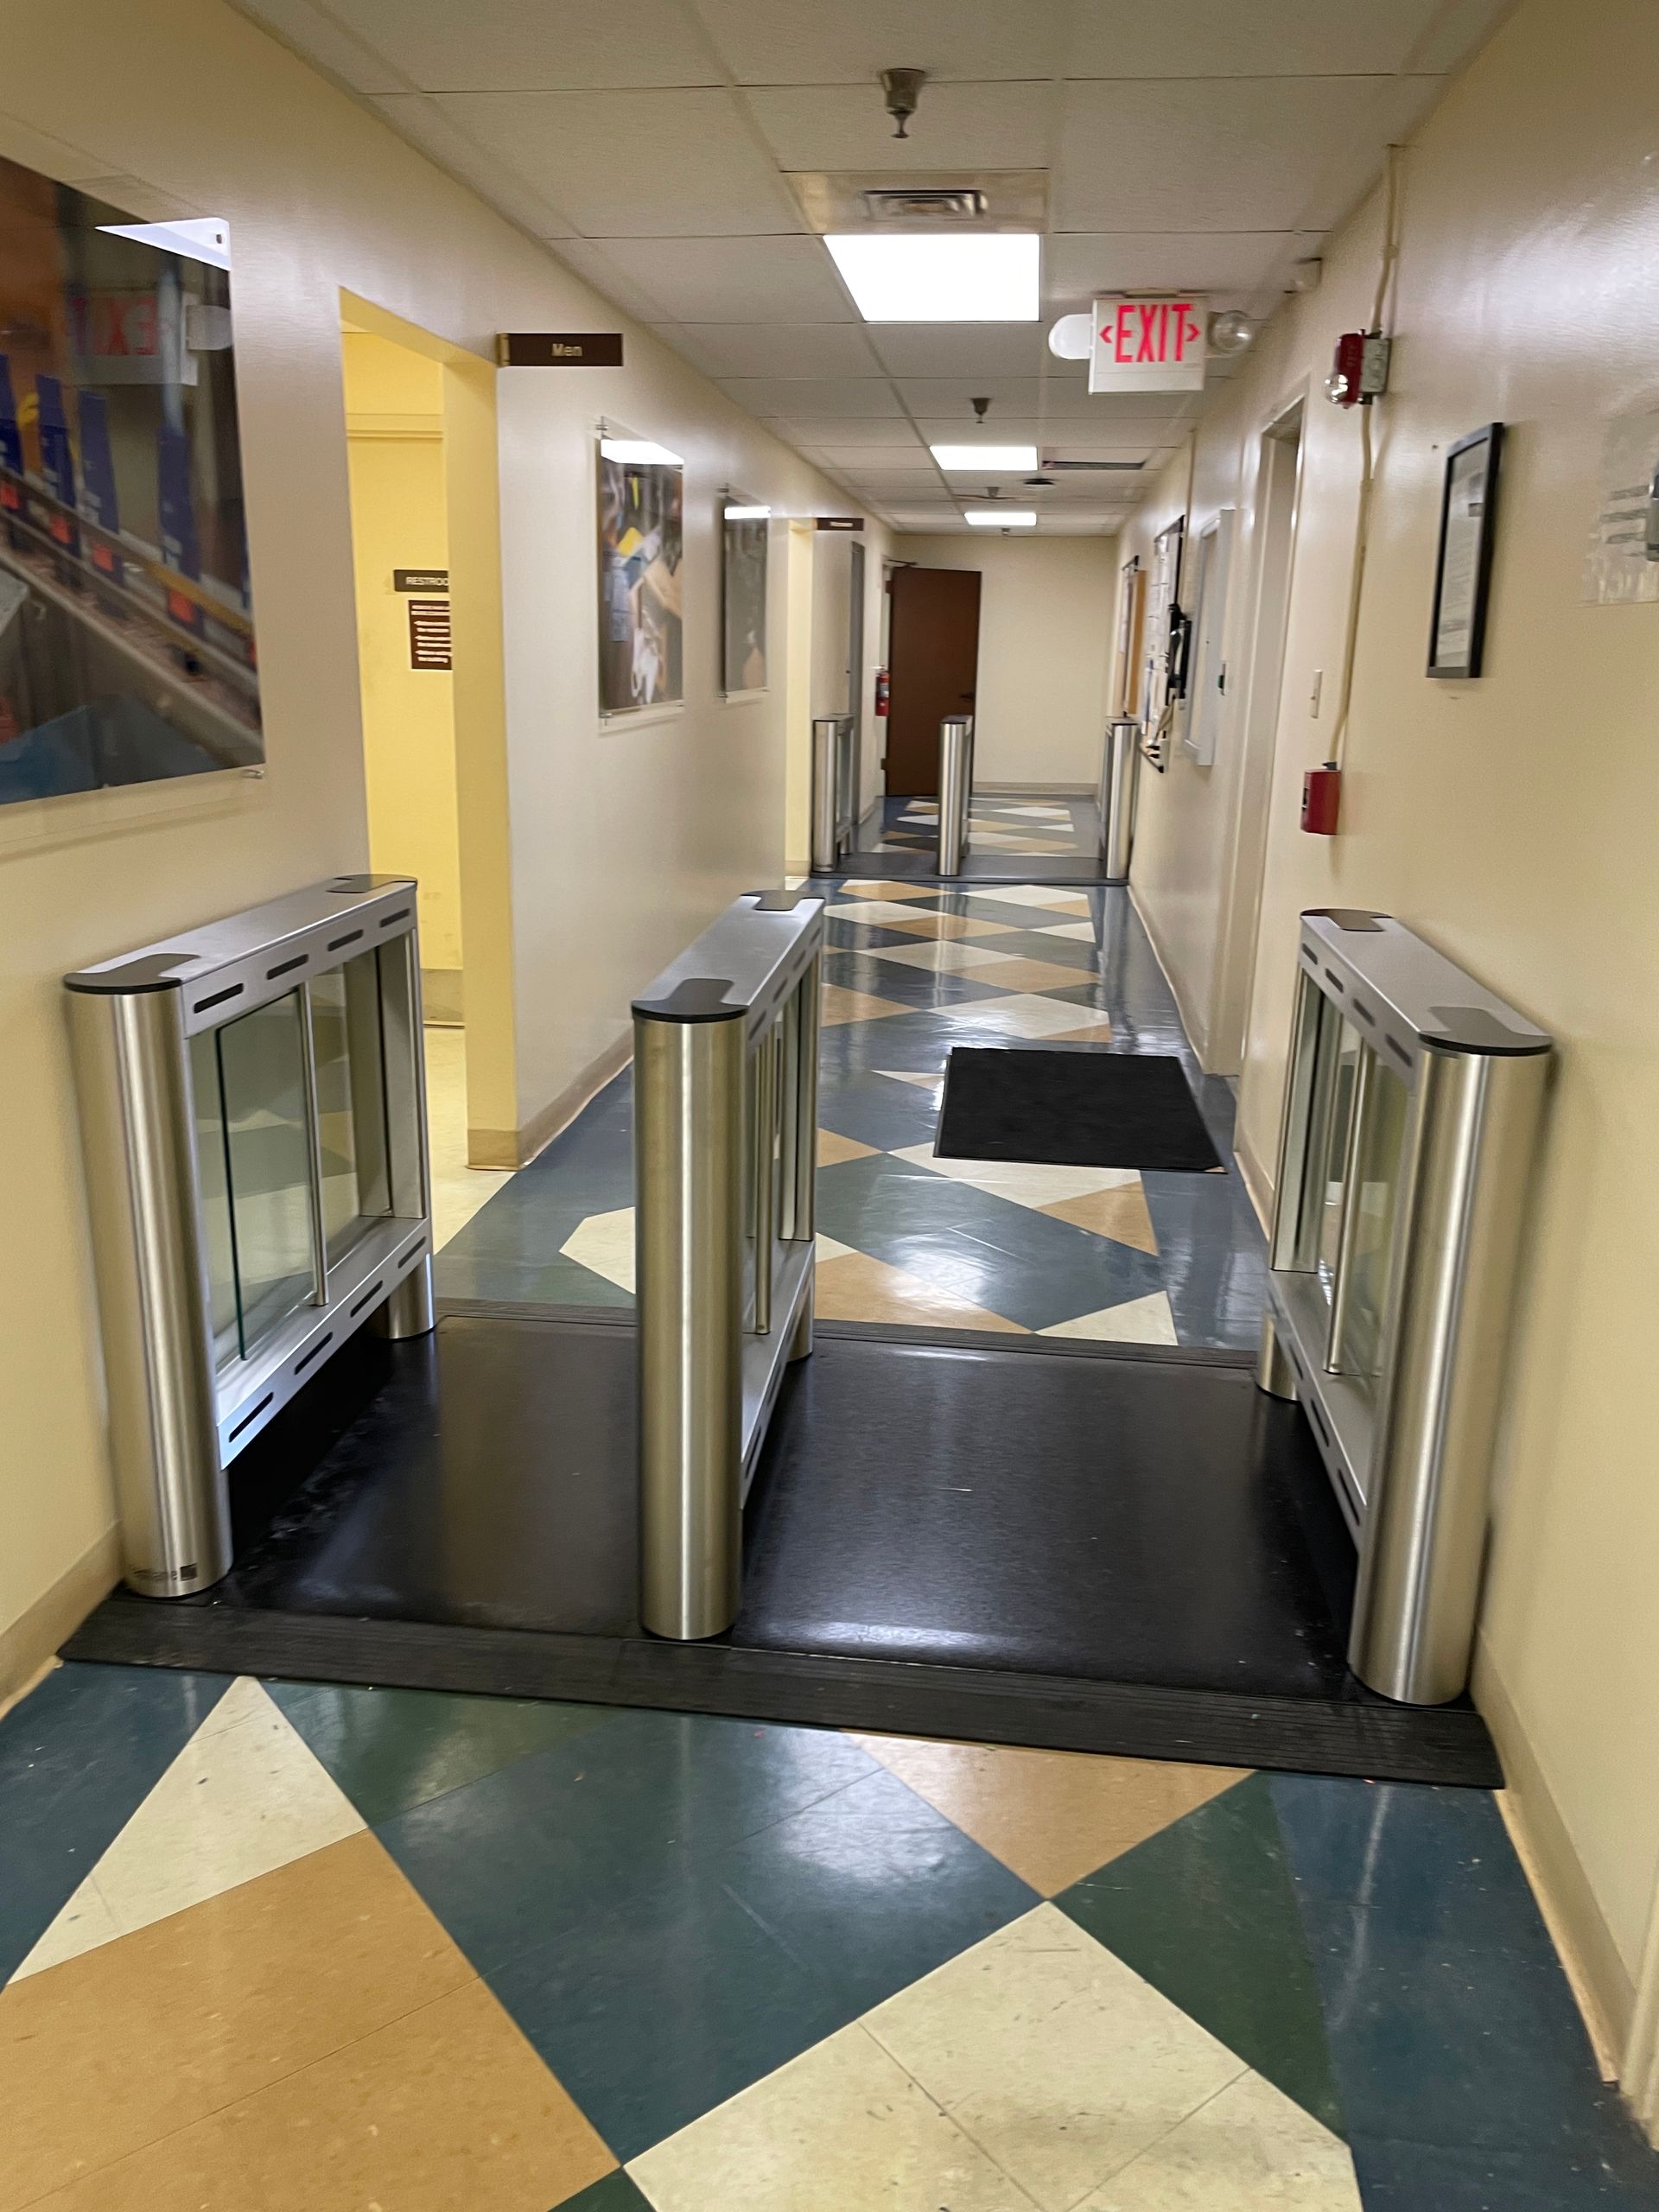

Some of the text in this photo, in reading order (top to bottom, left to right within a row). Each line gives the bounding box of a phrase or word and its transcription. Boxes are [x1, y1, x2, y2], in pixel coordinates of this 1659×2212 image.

[1115, 303, 1193, 363] EXIT
[552, 343, 583, 357] Men
[406, 576, 449, 586] RESTROO
